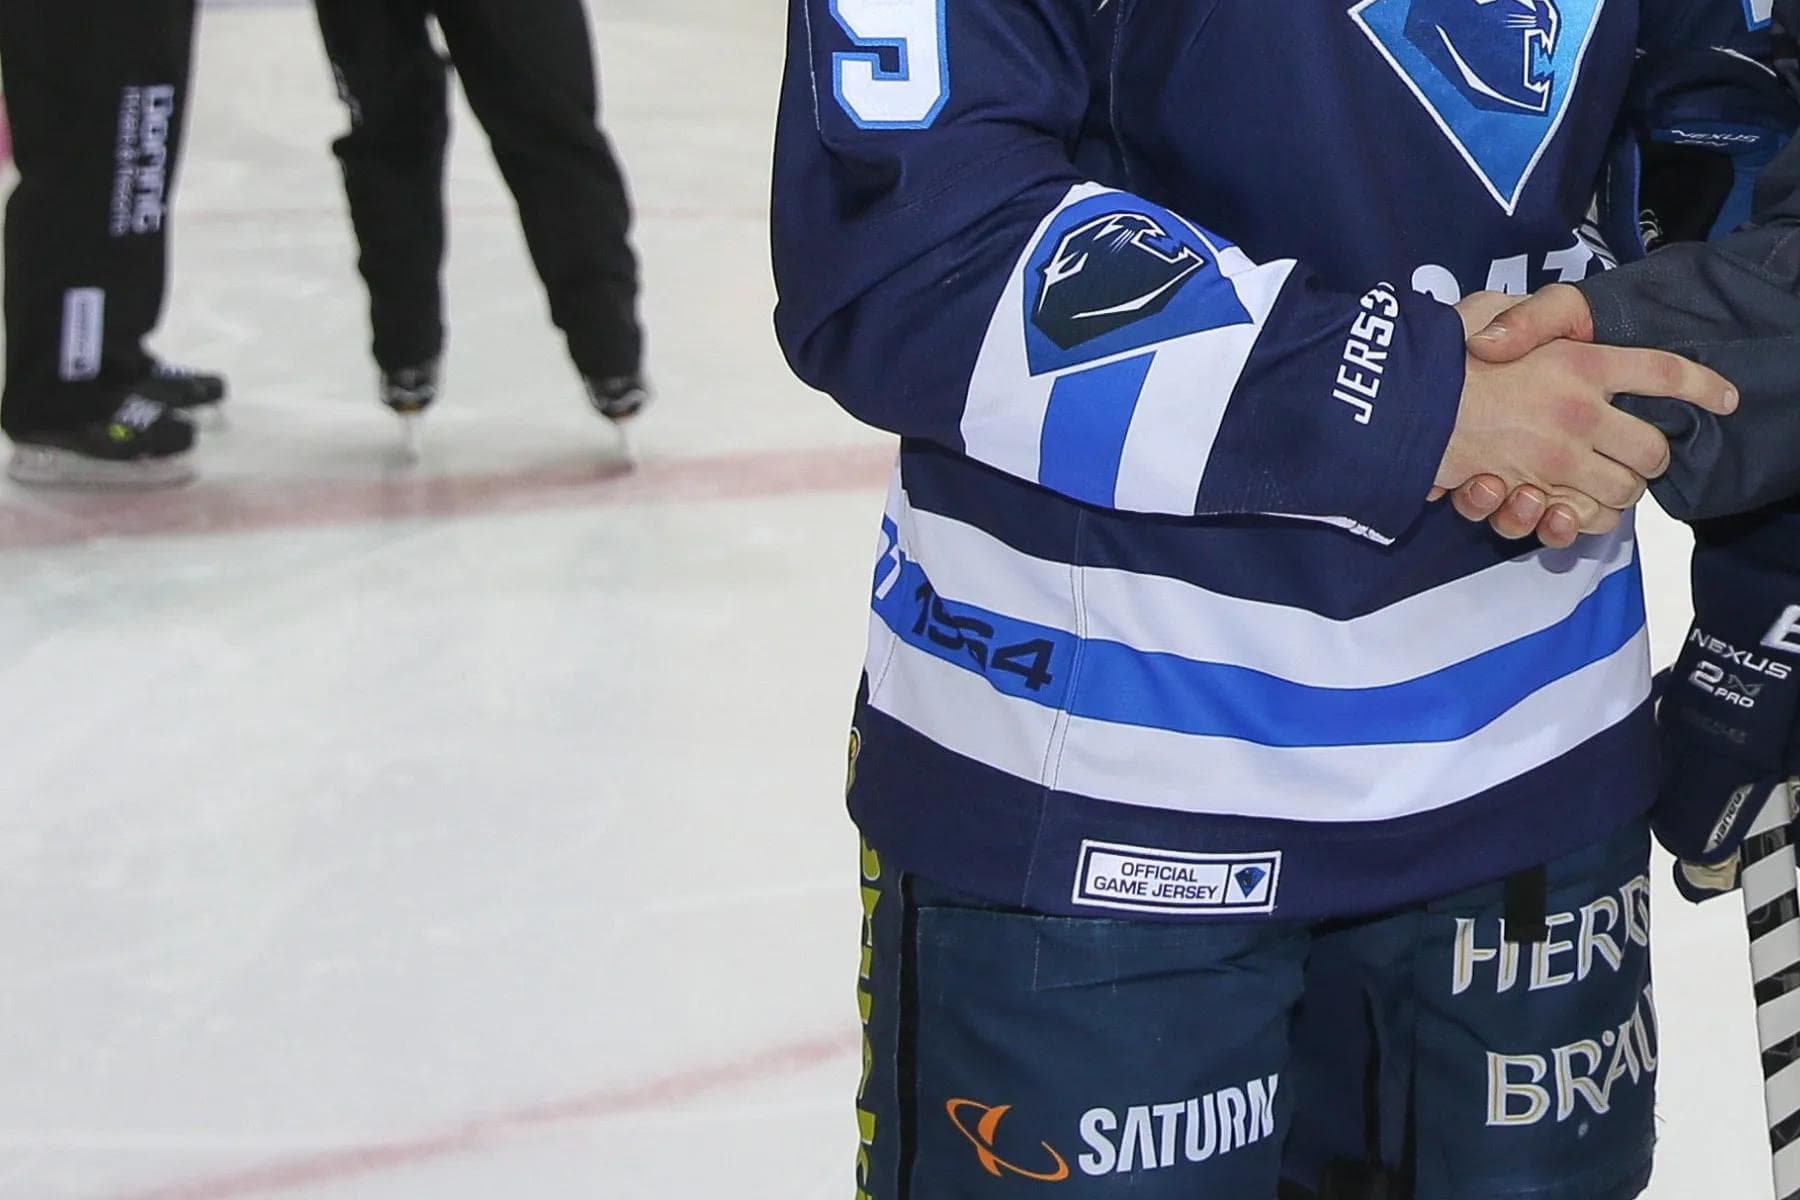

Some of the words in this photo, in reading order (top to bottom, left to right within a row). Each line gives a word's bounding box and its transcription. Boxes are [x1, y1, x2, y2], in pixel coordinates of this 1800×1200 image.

[1689, 627, 1792, 680] NEXUS
[1714, 687, 1755, 708] PRO
[1121, 862, 1198, 883] OFFICIAL
[1093, 876, 1149, 896] GAME
[1151, 884, 1219, 900] JERSEY
[1078, 1073, 1279, 1176] SATURN
